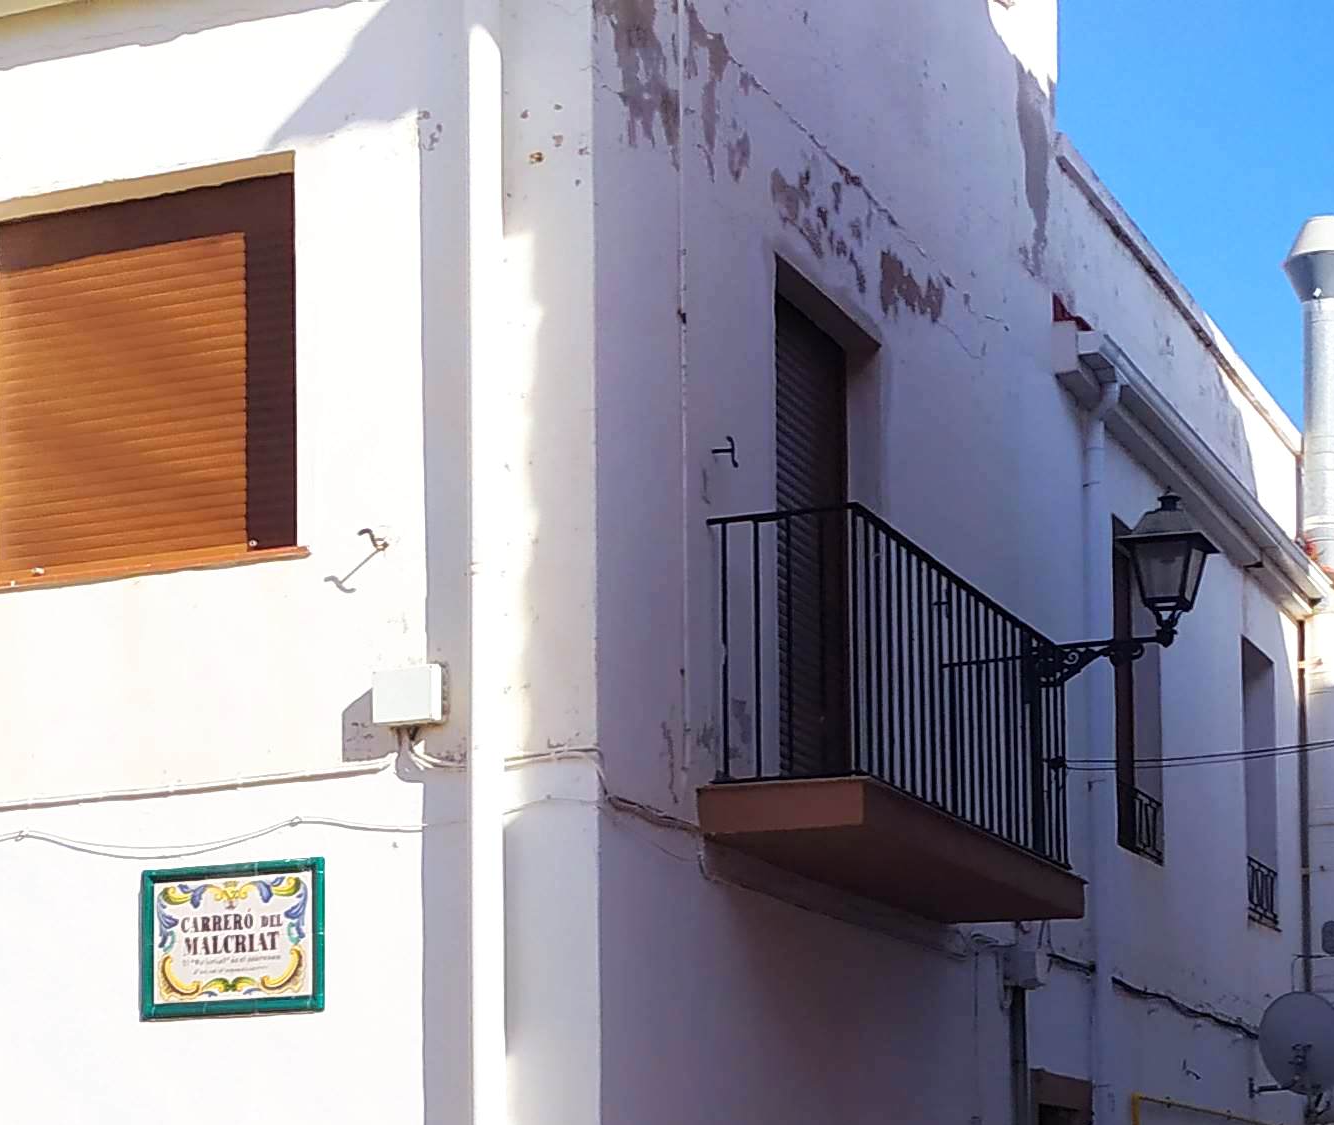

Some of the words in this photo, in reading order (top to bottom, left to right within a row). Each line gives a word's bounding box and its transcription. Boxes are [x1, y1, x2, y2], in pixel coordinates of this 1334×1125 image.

[181, 908, 254, 933] CARRERÓ
[260, 914, 283, 928] DEL
[183, 931, 280, 956] MALCRIAT
